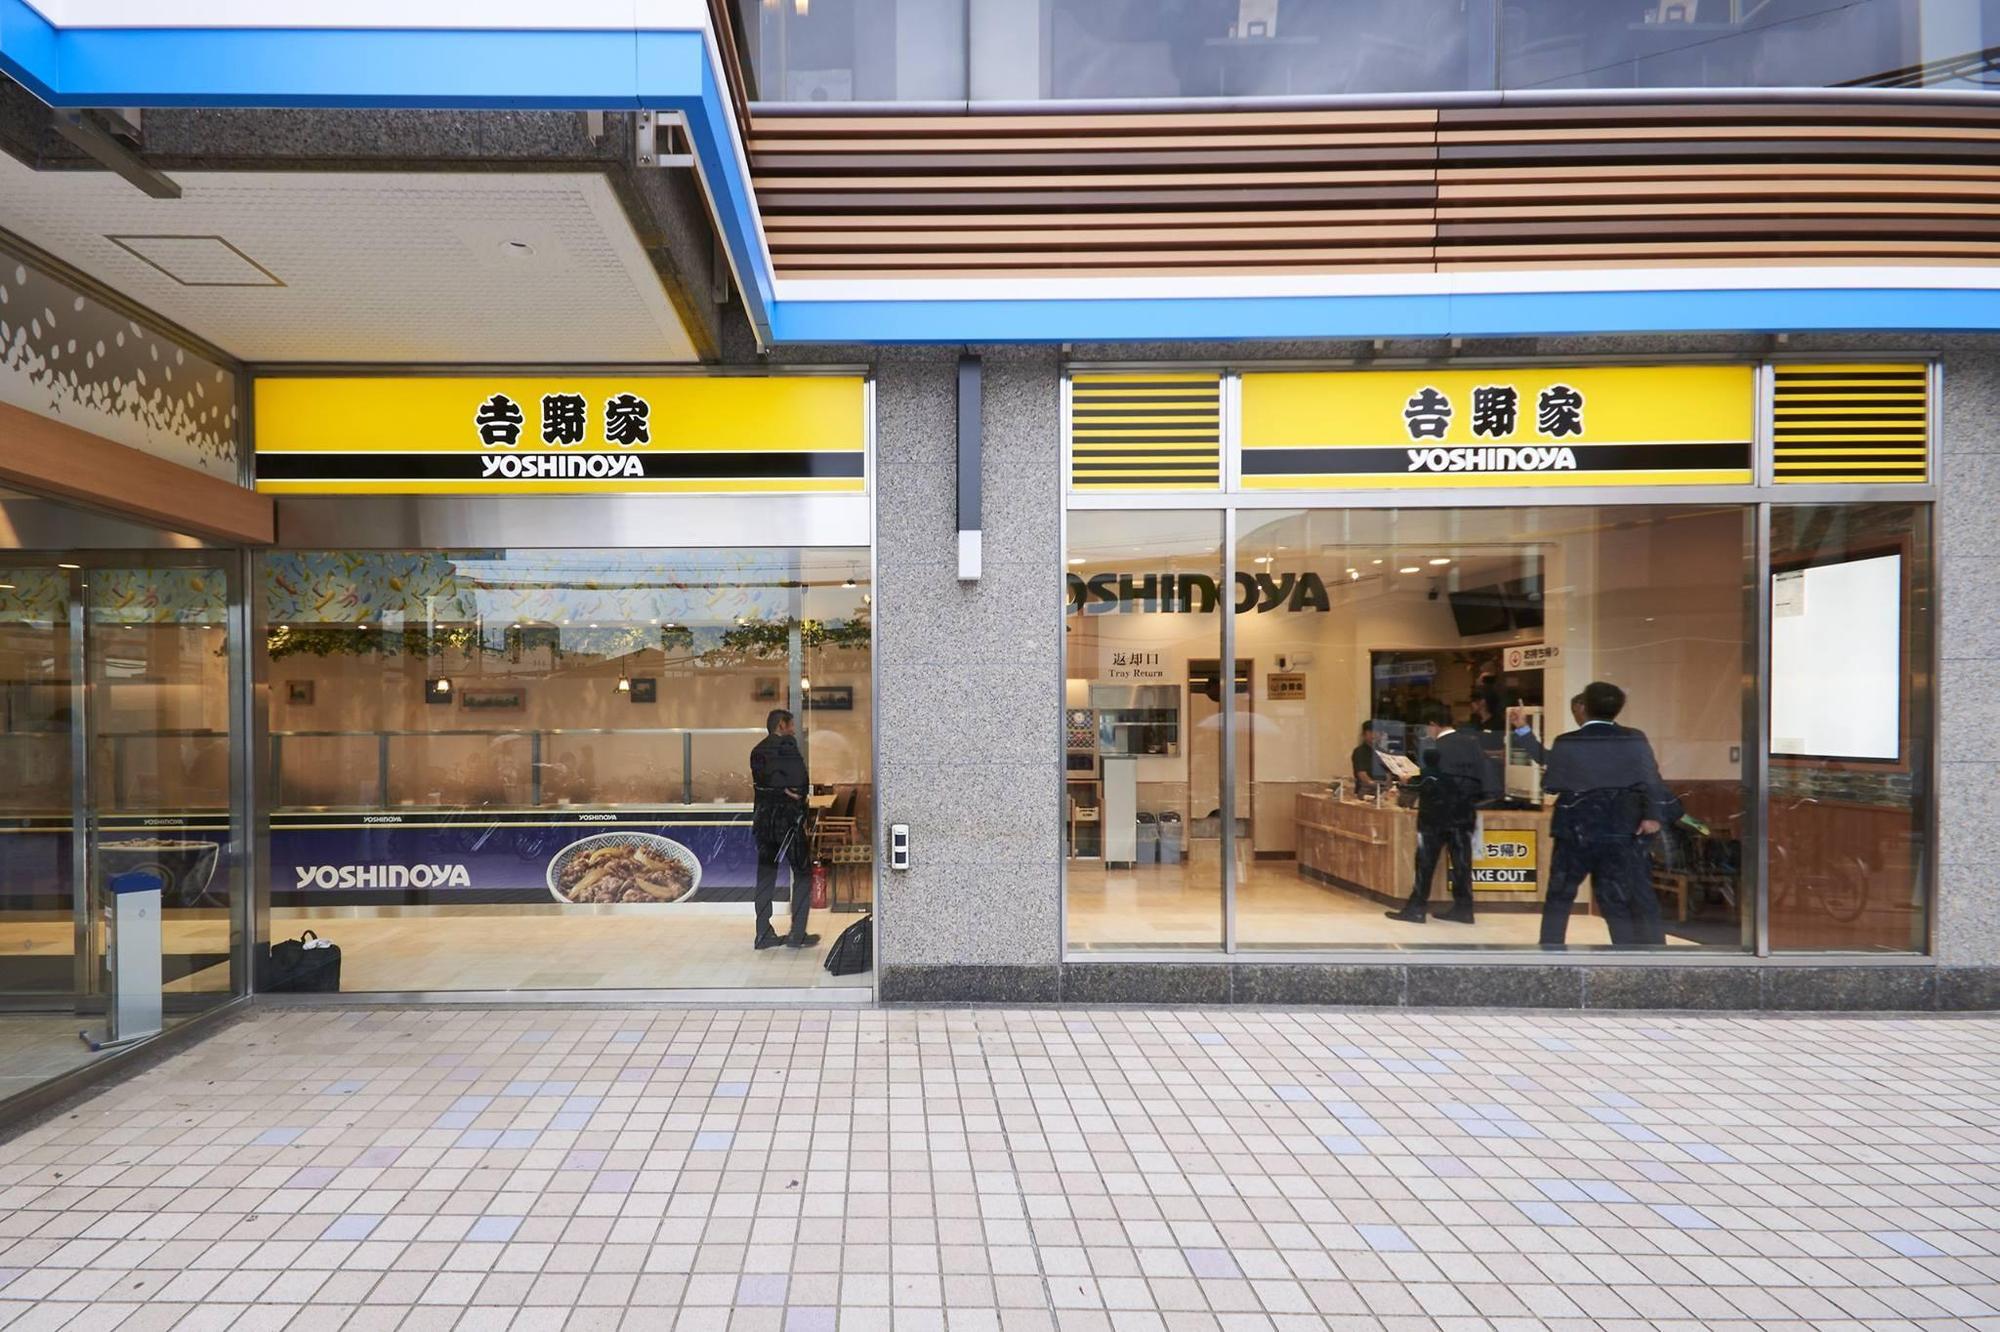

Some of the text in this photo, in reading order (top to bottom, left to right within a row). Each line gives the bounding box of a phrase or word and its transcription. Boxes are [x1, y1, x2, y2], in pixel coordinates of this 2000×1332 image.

[481, 455, 644, 478] YOSHINOYA
[1407, 447, 1577, 472] YOSHINOYA
[1113, 652, 1158, 666] 返却口
[1110, 669, 1163, 678] Tray Return
[1484, 843, 1528, 857] ち帰り
[296, 863, 471, 889] YOSHINOYA
[1496, 870, 1527, 881] OUT
